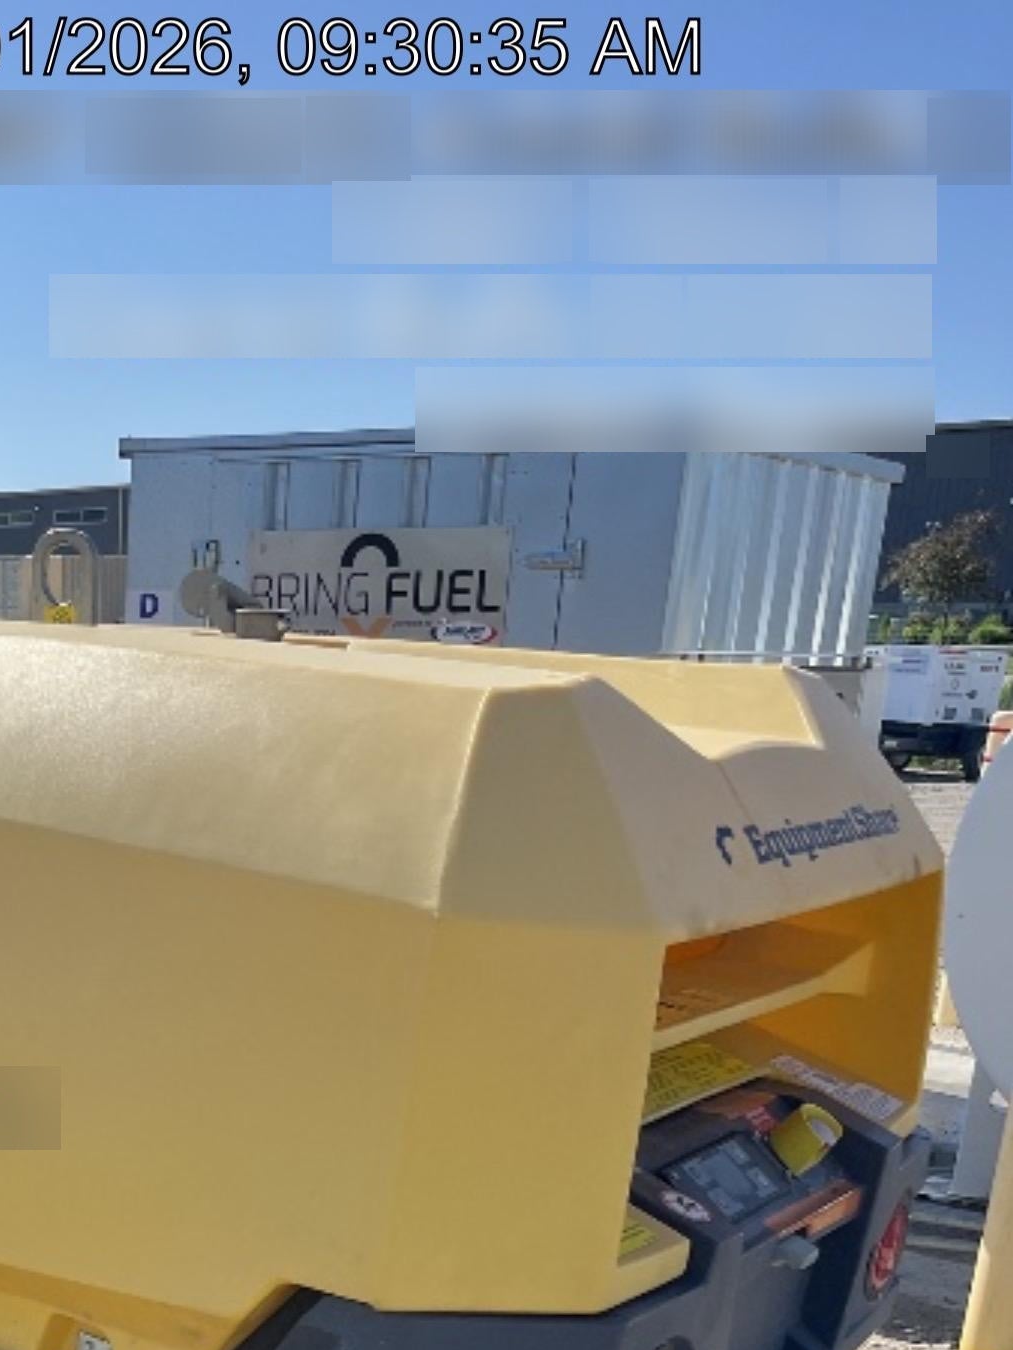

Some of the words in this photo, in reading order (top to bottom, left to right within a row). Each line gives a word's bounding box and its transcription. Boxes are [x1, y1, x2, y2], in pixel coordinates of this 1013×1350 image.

[138, 592, 159, 619] D
[252, 572, 370, 617] BRING
[385, 569, 501, 615] FUEL
